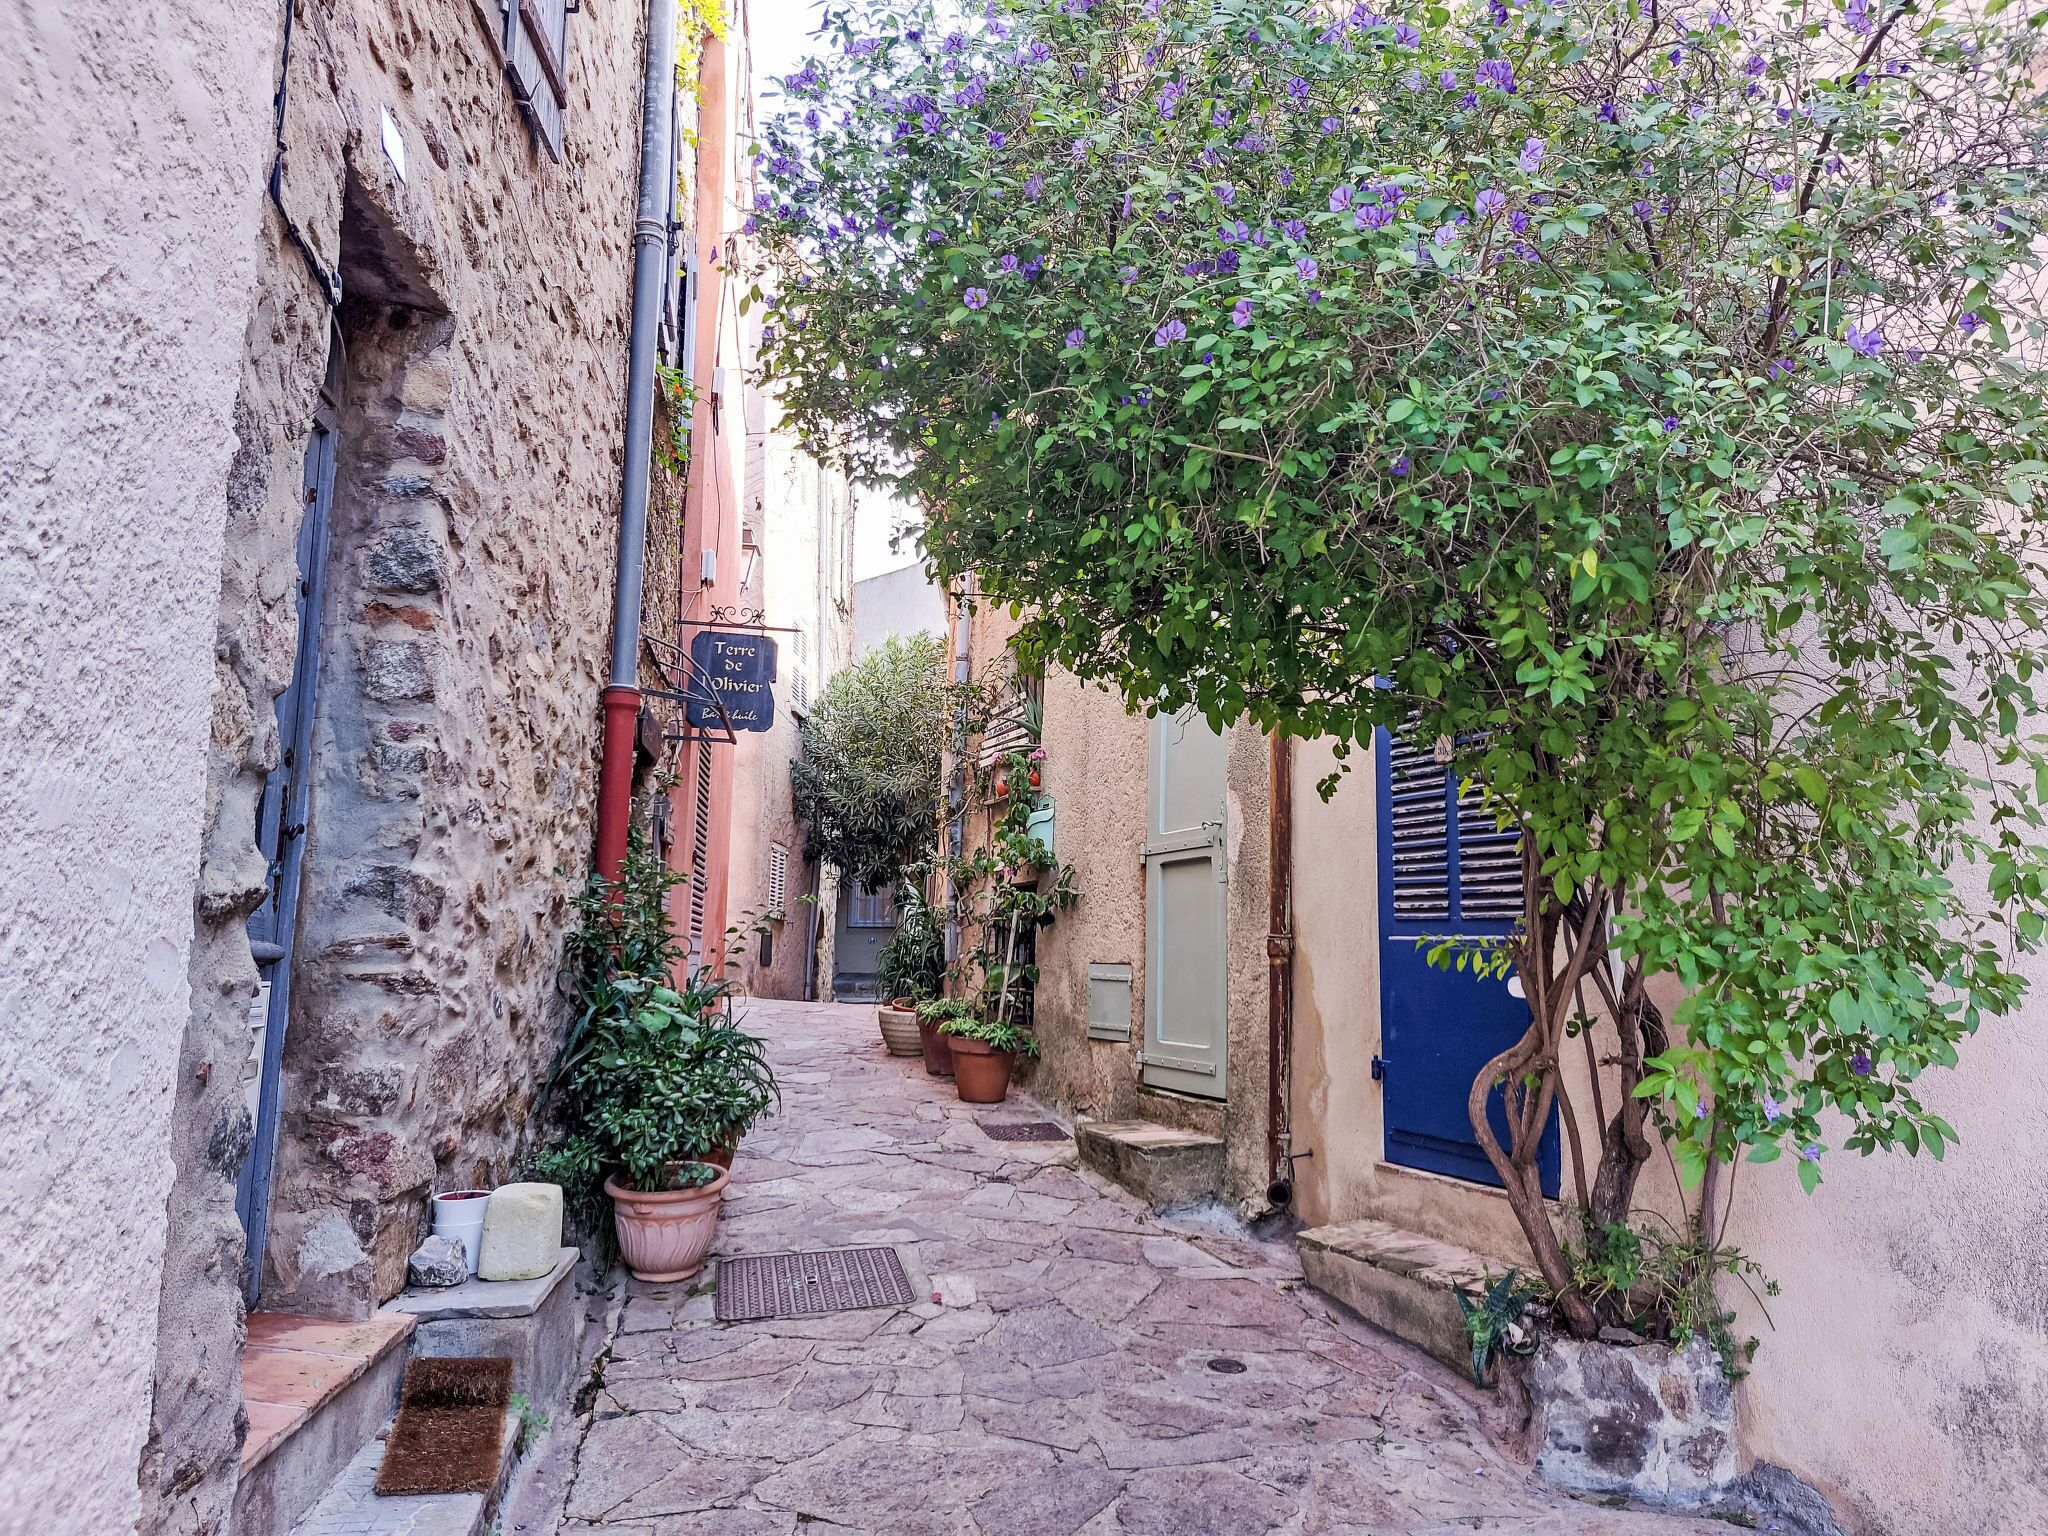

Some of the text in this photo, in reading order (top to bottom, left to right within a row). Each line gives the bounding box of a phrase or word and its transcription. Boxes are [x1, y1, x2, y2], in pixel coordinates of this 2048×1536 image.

[714, 641, 756, 657] Terre
[725, 658, 743, 671] de
[702, 675, 763, 692] lOlivier
[731, 709, 758, 721] huile
